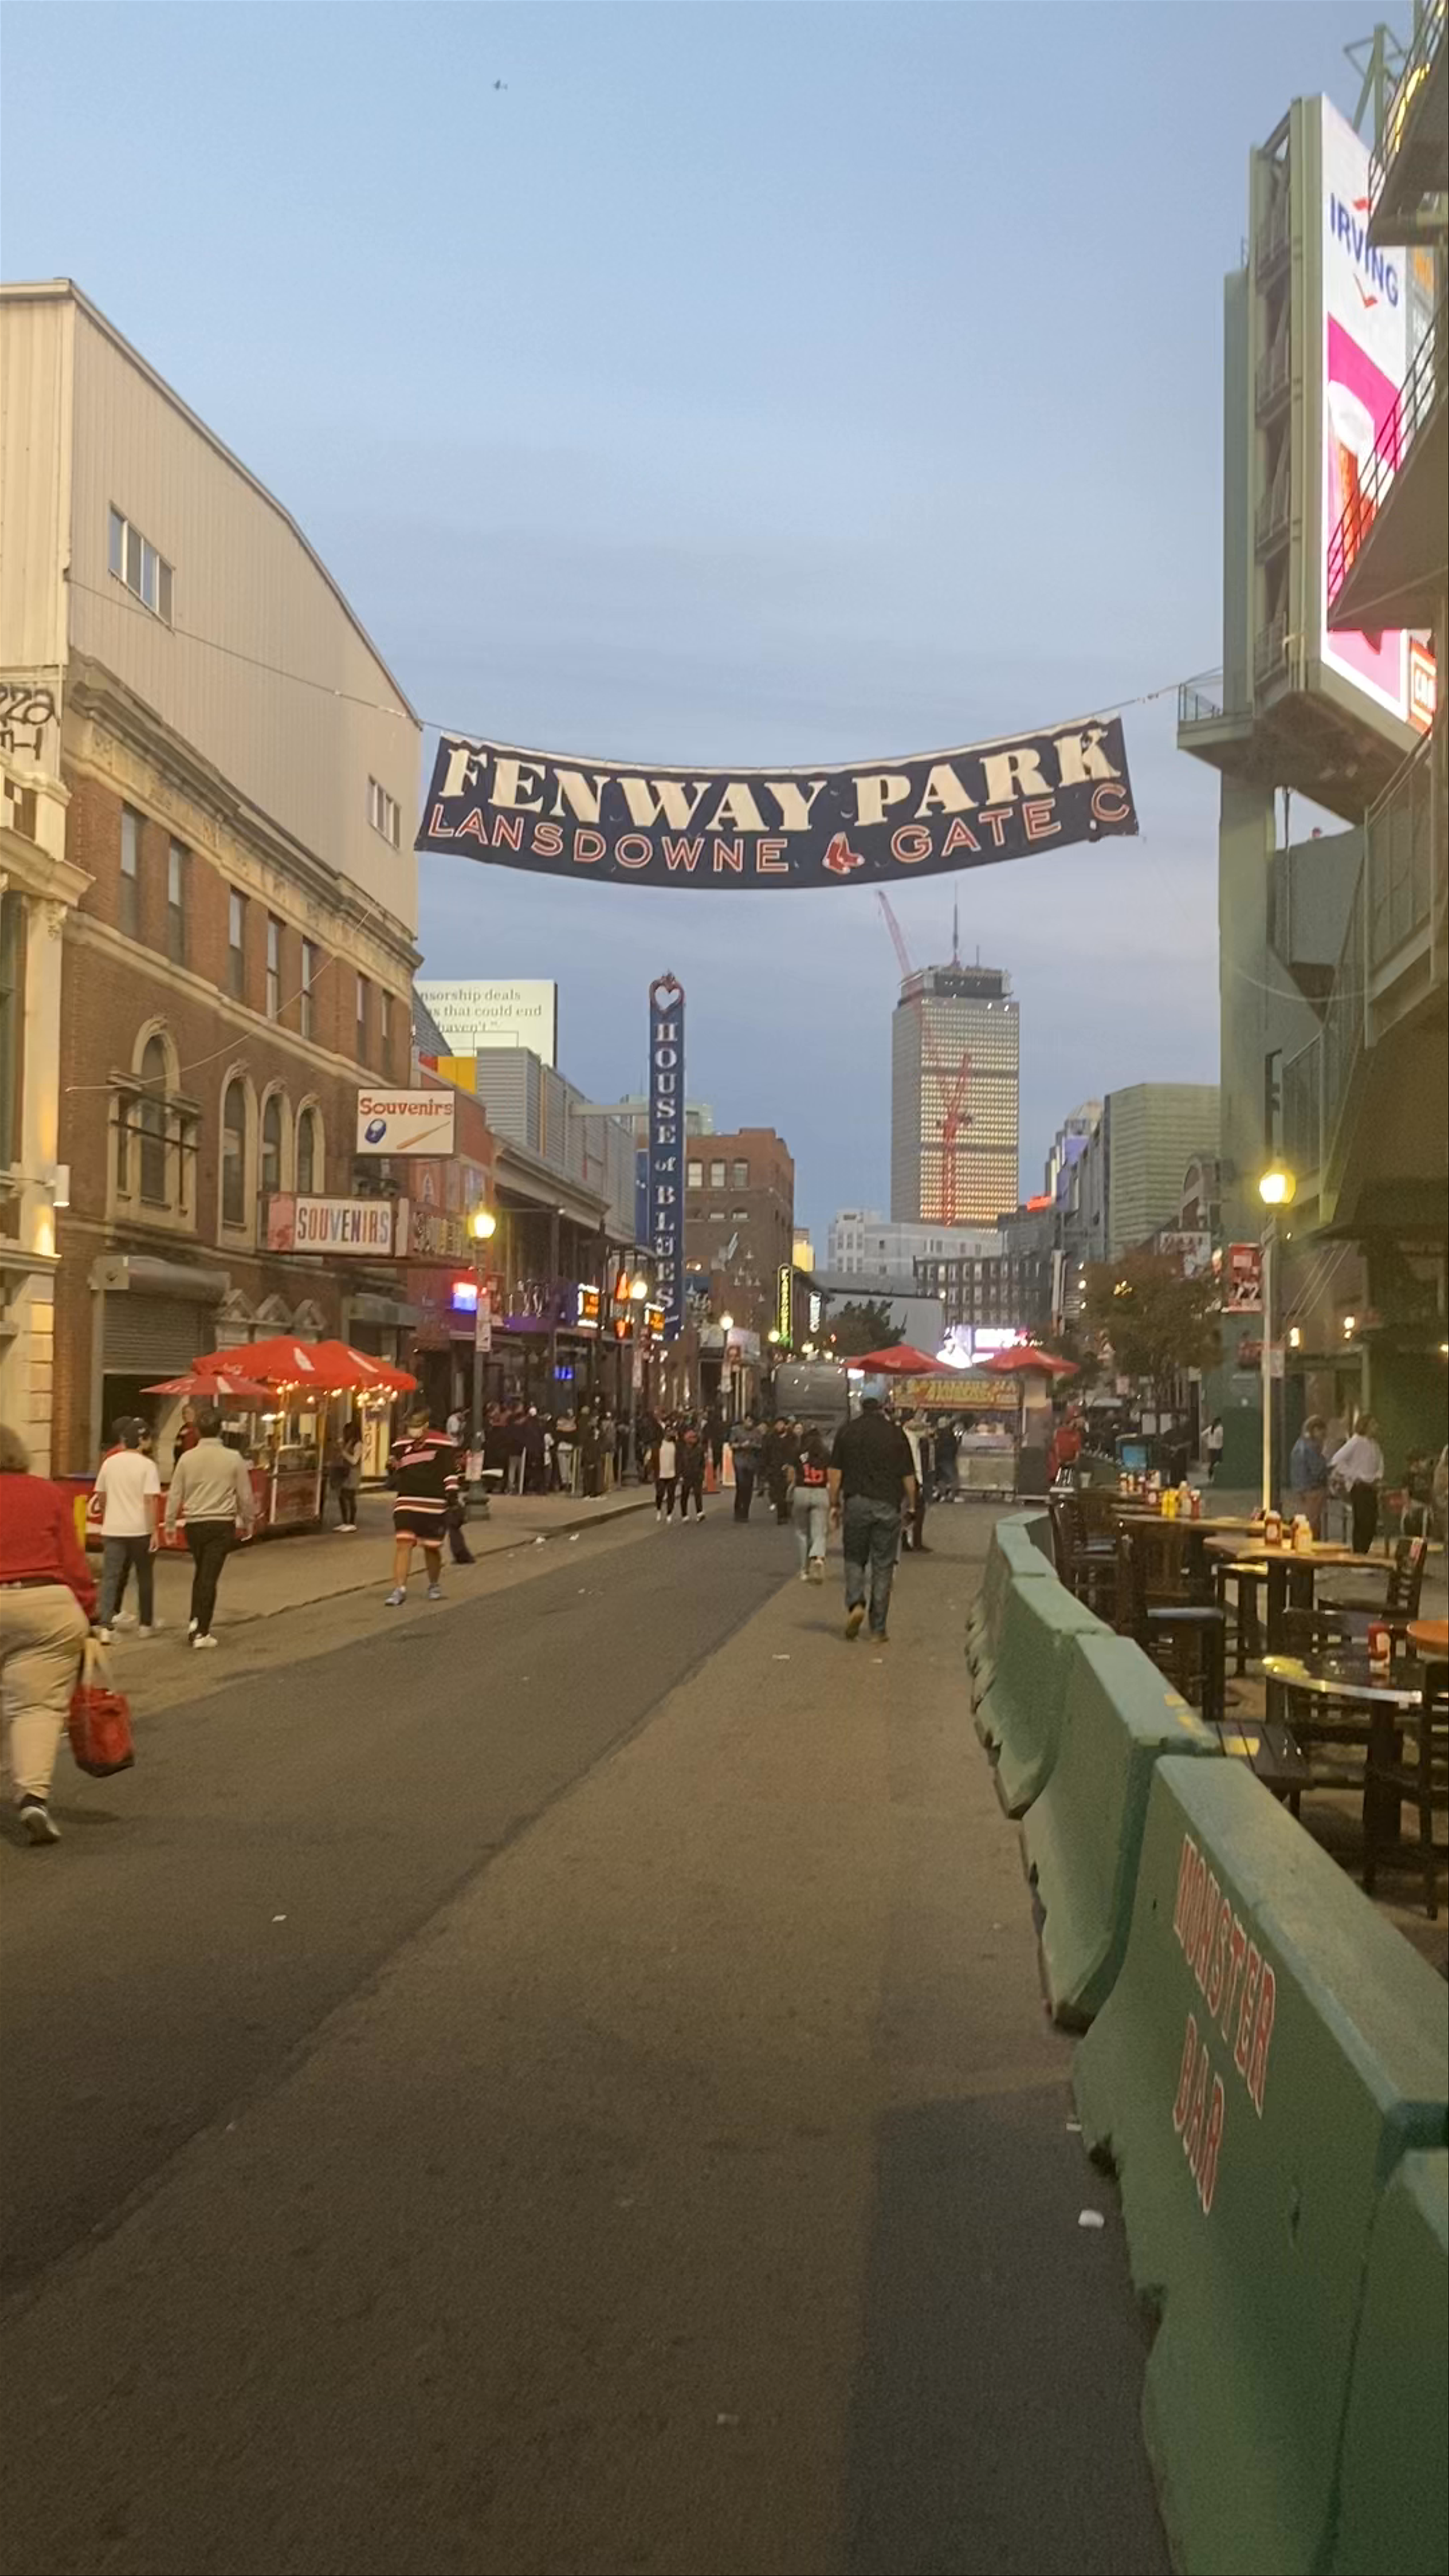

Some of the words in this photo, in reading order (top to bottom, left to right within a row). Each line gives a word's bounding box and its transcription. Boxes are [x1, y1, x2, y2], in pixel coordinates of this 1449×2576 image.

[1331, 192, 1398, 308] IRVING
[428, 803, 789, 872] LANSDOWNE
[891, 798, 1061, 863] GATE
[1091, 782, 1130, 823] C
[438, 749, 827, 832] FENWAY
[852, 729, 1121, 826] PARK
[445, 1004, 470, 1016] that
[475, 1005, 512, 1017] could
[517, 1004, 541, 1016] end
[485, 989, 520, 1000] deals
[360, 1097, 452, 1116] Souvenirs
[654, 1022, 678, 1144] HOUSE
[655, 1156, 676, 1172] of
[297, 1207, 389, 1243] SOUVENIRS
[655, 1185, 676, 1309] BLUES
[1174, 1833, 1276, 2119] MONSTER
[1173, 2013, 1224, 2216] BAR
